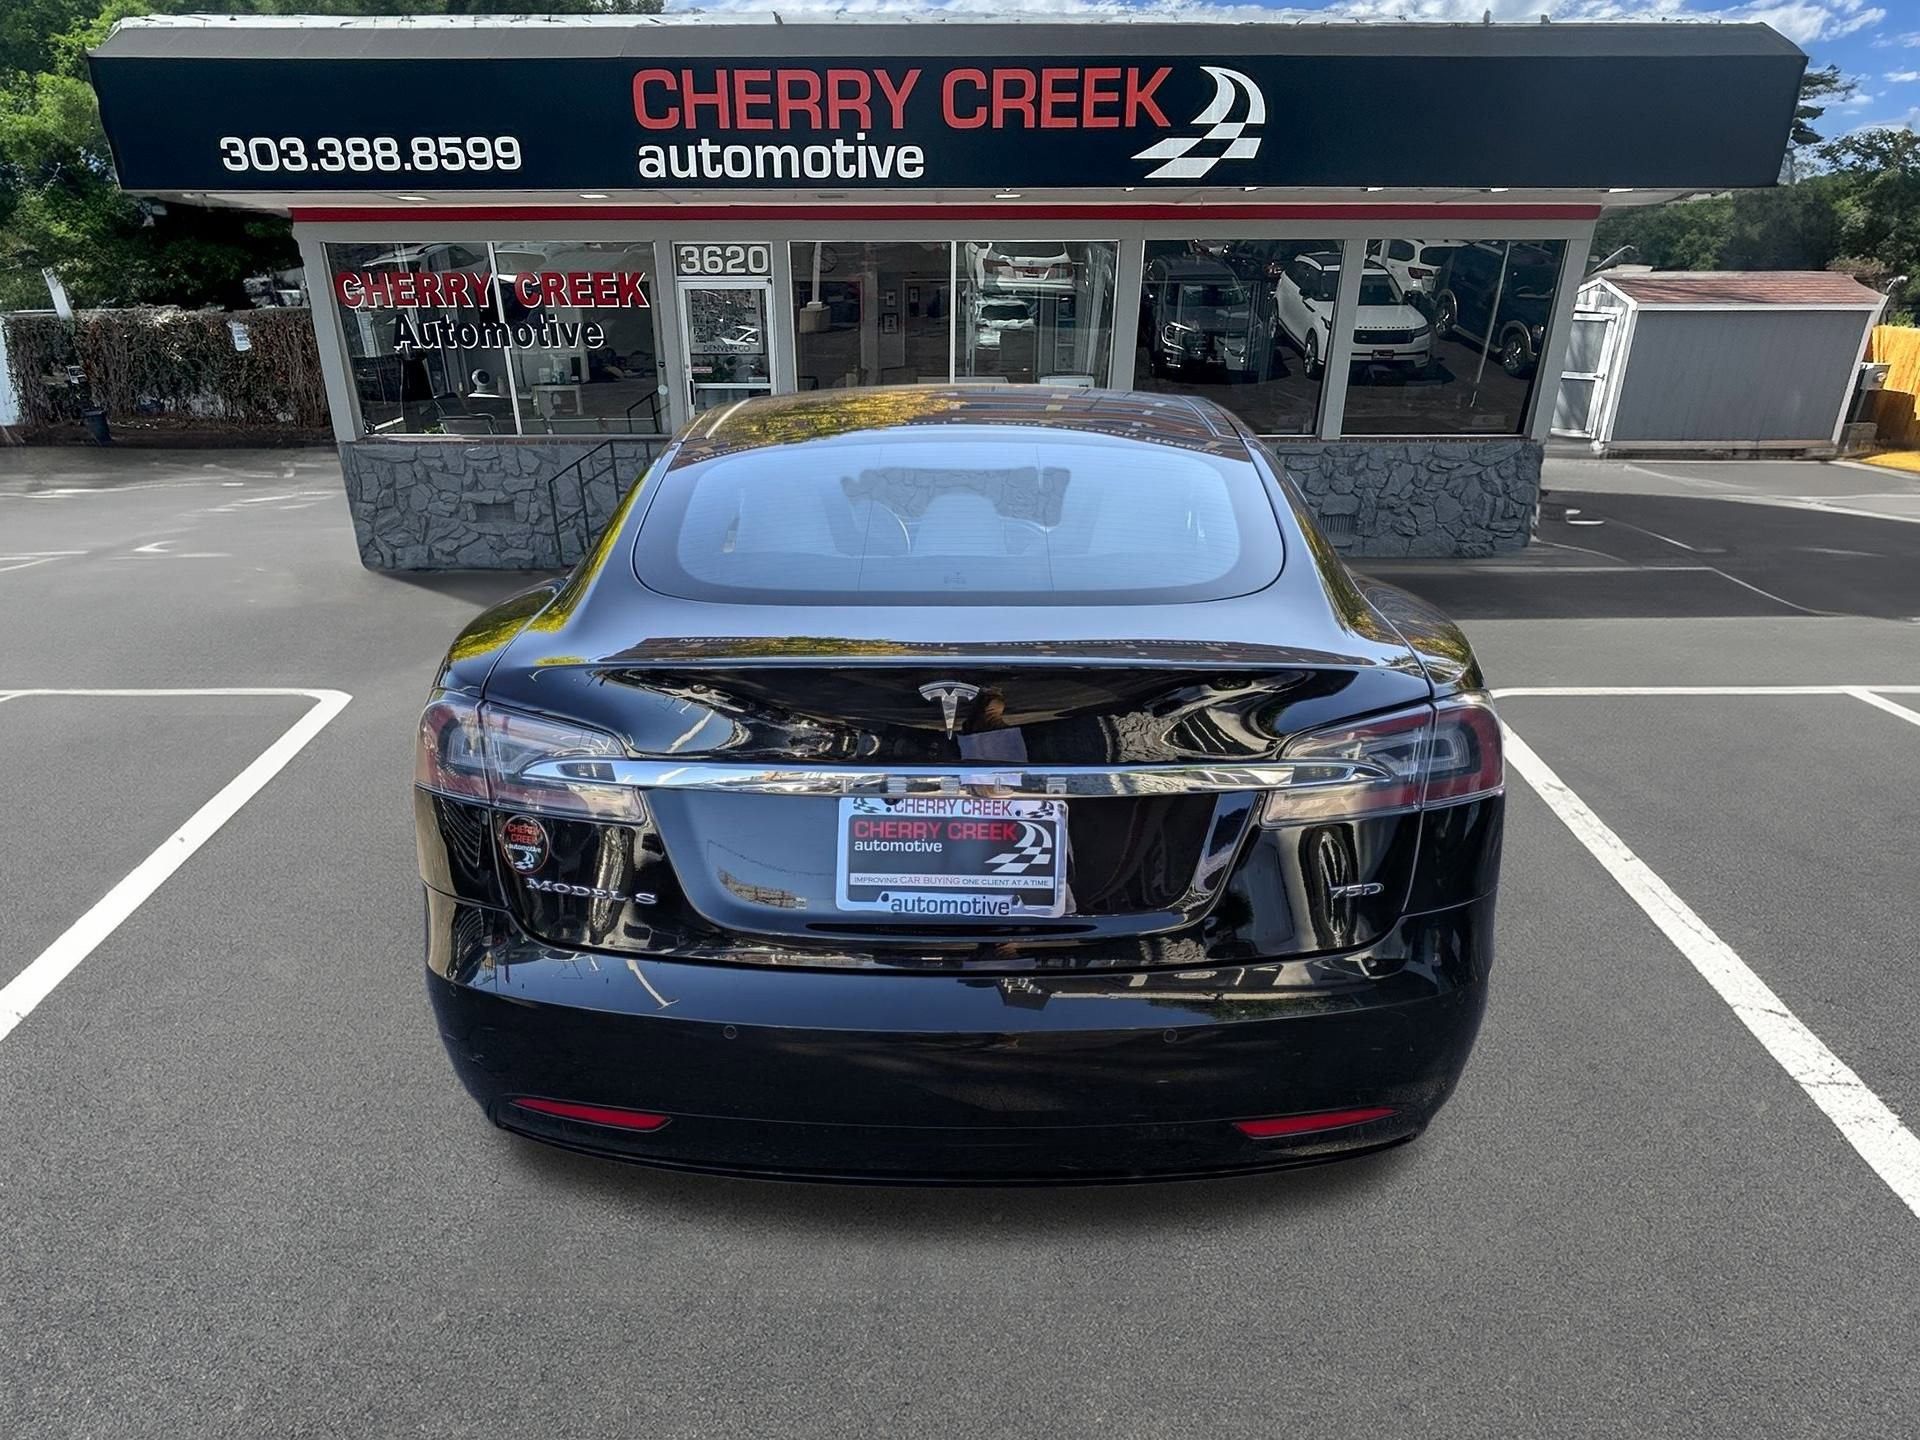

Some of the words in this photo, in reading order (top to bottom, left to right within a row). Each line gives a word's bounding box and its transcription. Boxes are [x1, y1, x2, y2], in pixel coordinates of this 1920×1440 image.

[632, 68, 922, 131] CHERRY
[942, 66, 1174, 129] CREEK
[219, 135, 522, 172] 303.388.8599
[638, 132, 924, 179] automotive
[680, 245, 769, 273] 3620
[335, 271, 493, 309] CHERRY
[515, 271, 650, 309] CREEK
[393, 313, 605, 350] Automotive
[895, 799, 956, 815] CHERRY
[961, 800, 1012, 816] CREEK
[854, 820, 944, 840] CHERRY
[948, 823, 1017, 841] CREEK
[854, 837, 943, 853] automotive
[526, 877, 627, 901] MODEL
[635, 893, 657, 904] S
[854, 876, 898, 885] IMPROVING
[899, 876, 920, 884] CAR
[923, 876, 960, 885] BUYING
[962, 878, 979, 886] ONE
[981, 879, 1009, 887] CLIENT
[1023, 879, 1031, 887] A
[1032, 879, 1049, 887] TIME
[890, 894, 1010, 916] automotive
